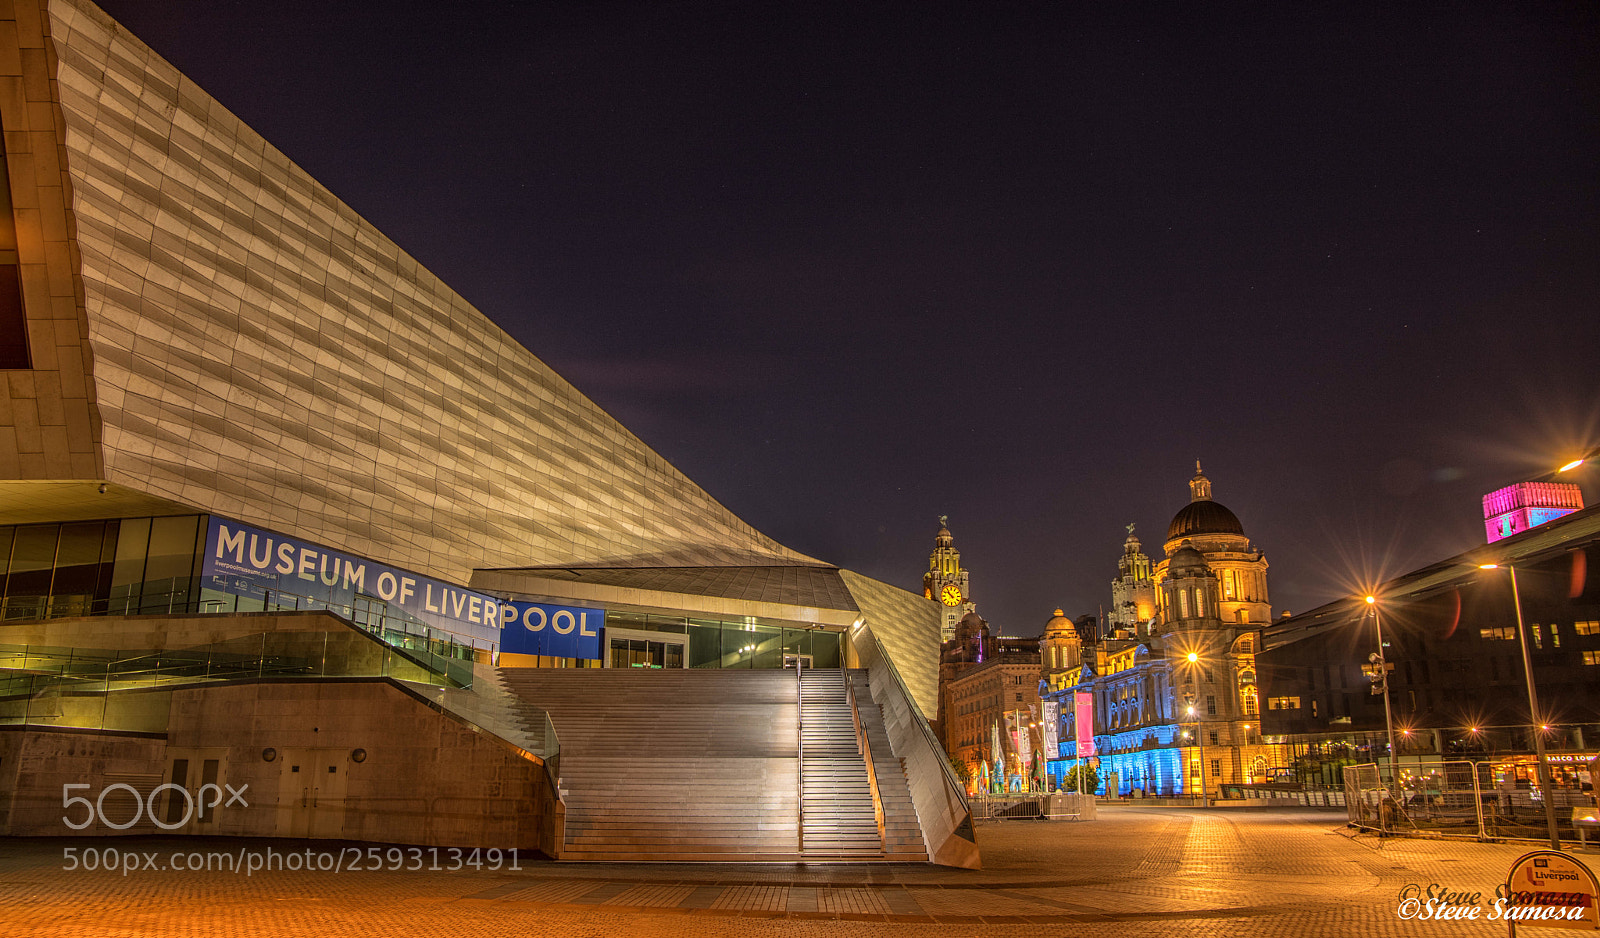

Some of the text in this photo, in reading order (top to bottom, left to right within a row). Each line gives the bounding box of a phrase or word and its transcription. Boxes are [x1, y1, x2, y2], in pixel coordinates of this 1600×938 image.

[215, 525, 597, 638] MUSEUM OF LIVERPOOL
[1535, 871, 1580, 881] Liverpool
